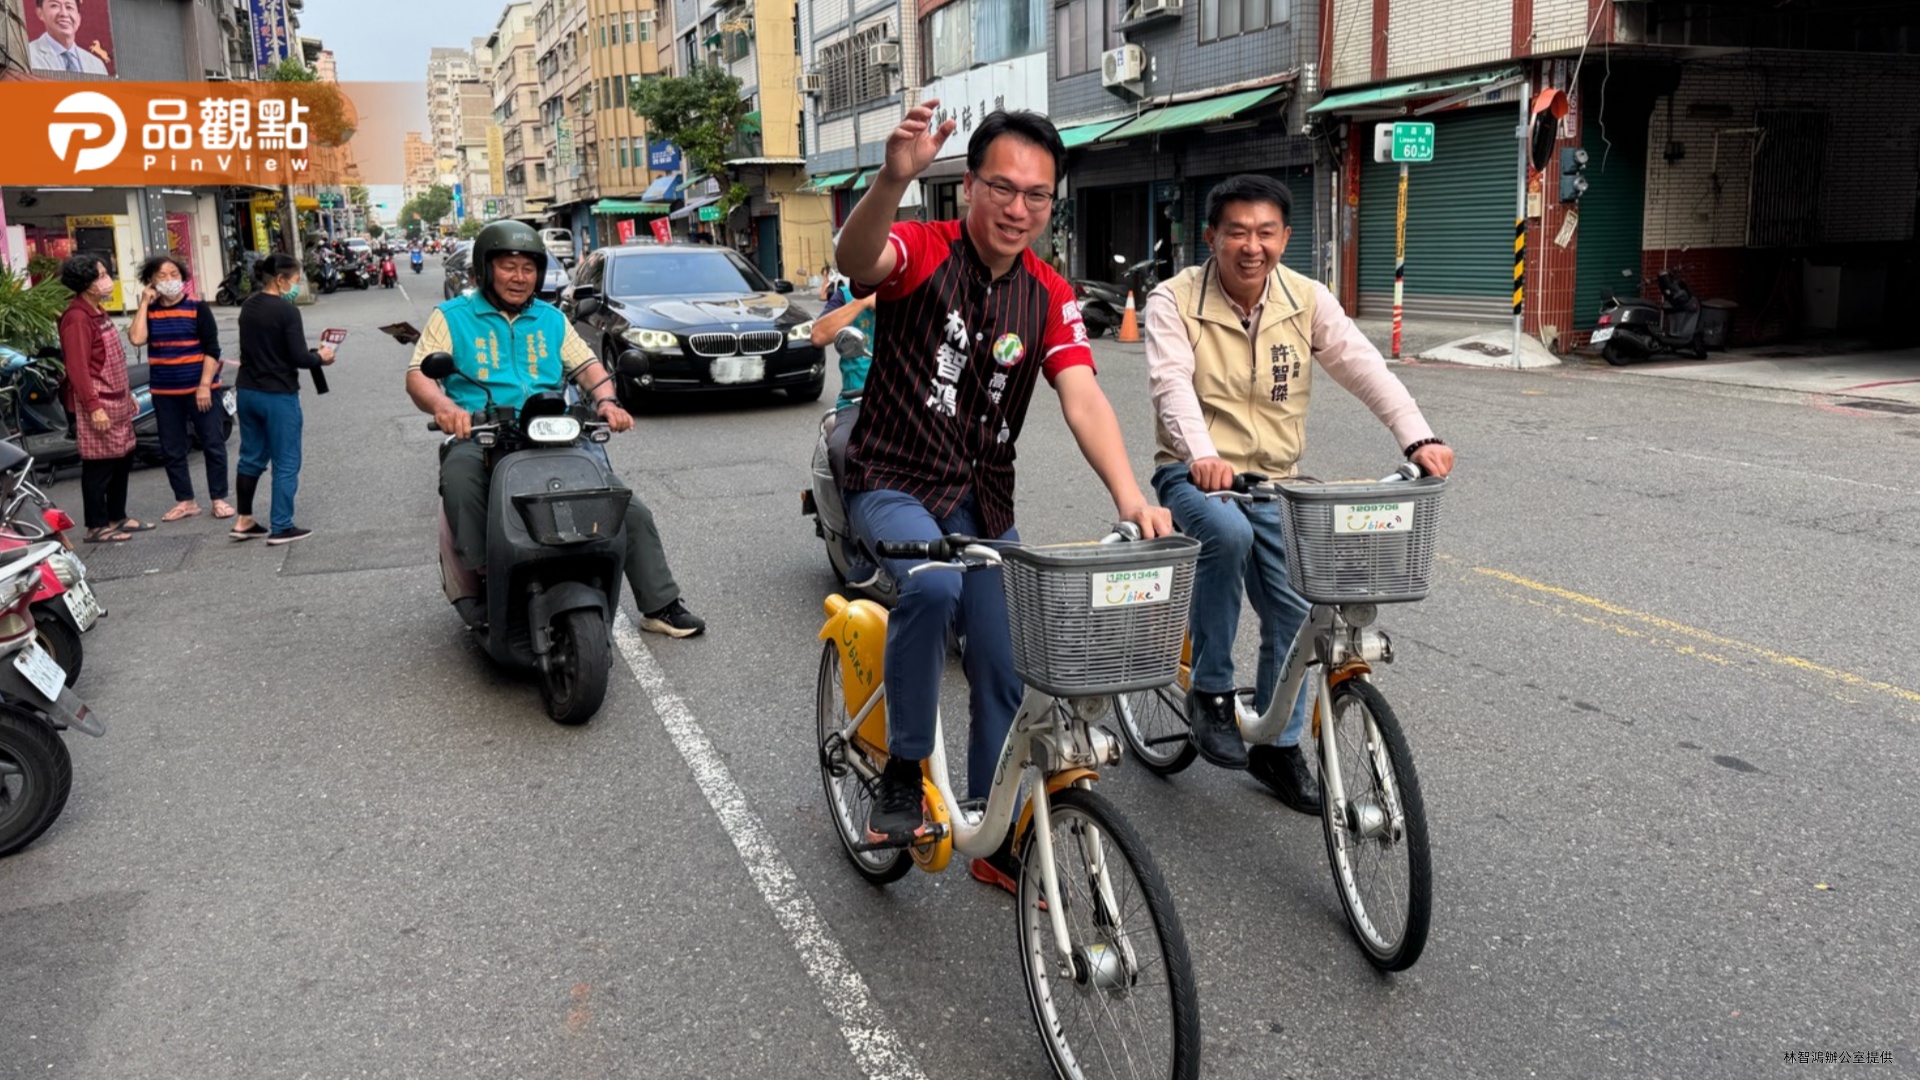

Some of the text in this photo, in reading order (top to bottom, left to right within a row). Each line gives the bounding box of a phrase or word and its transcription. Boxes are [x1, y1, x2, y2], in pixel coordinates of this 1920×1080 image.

[1404, 145, 1417, 158] 60
[926, 309, 970, 418] 林智鴻
[1270, 343, 1290, 402] 許智傑
[1350, 503, 1399, 512] 1209706
[1108, 570, 1159, 581] 1201344
